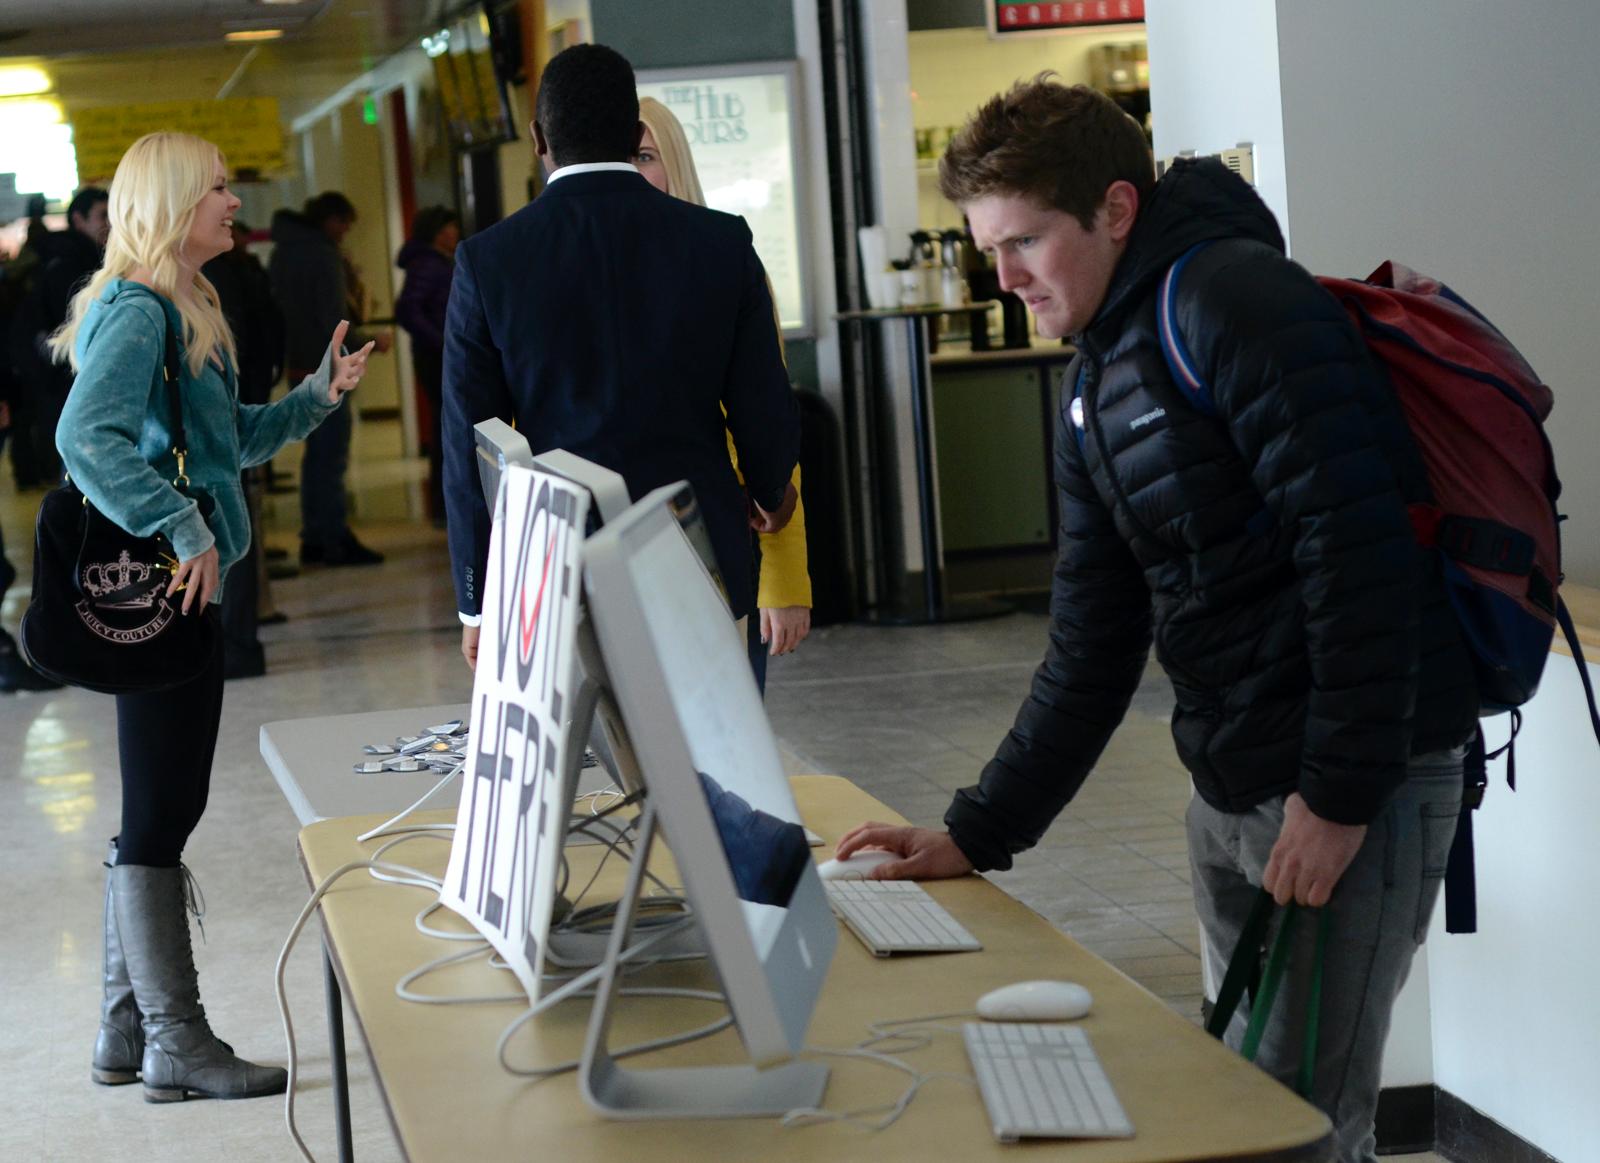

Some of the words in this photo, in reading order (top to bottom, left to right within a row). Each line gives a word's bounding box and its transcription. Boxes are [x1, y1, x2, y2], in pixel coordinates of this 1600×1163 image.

[685, 119, 748, 145] OURS
[83, 611, 110, 635] JUICY
[113, 616, 166, 641] COUTURE
[497, 474, 577, 727] VOTE
[459, 694, 557, 974] HERE
